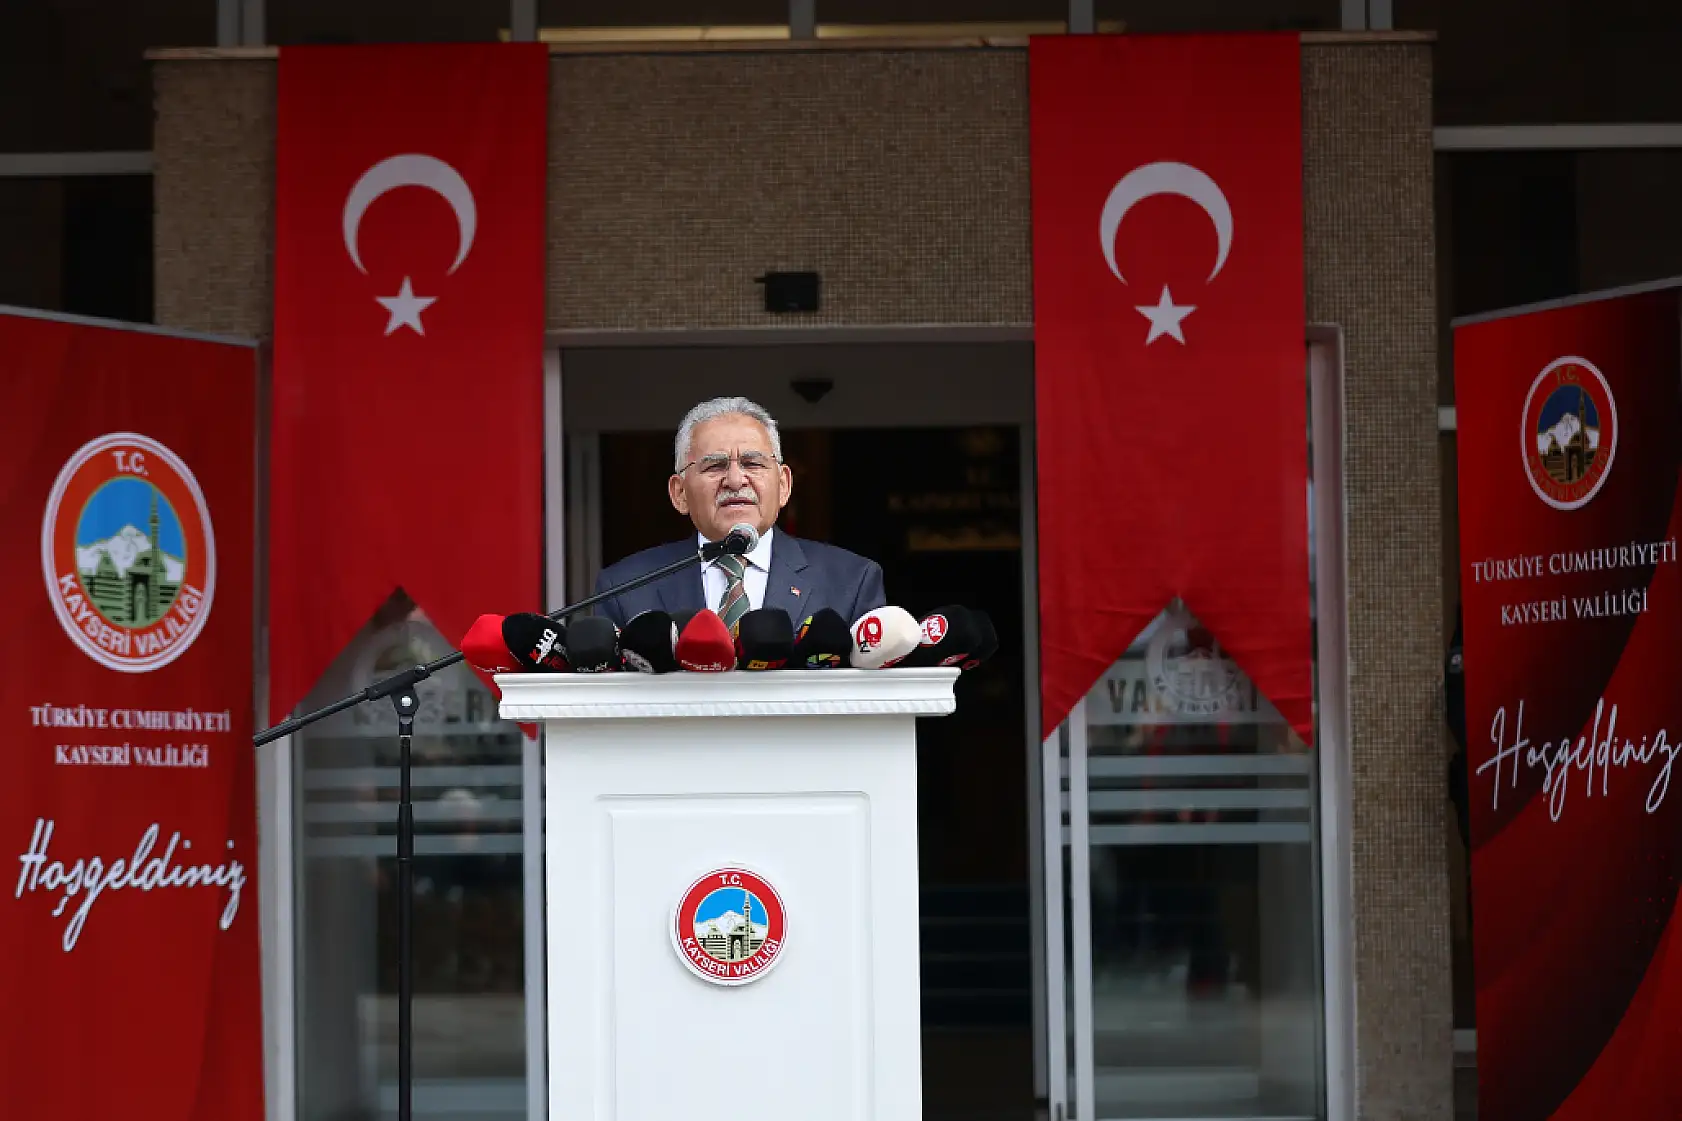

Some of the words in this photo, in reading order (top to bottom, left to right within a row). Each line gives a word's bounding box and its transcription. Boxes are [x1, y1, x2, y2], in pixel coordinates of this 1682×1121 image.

[111, 450, 149, 476] T.C.
[1471, 553, 1544, 583] TÜRKİYE
[1549, 536, 1677, 575] CUMHURİYETİ
[59, 572, 130, 656] KAYSERİ
[1500, 594, 1567, 626] KAYSERİ
[1572, 586, 1649, 618] VALİLİĞİ
[29, 702, 109, 728] TÜRKİYE
[110, 707, 231, 733] CUMHURİYETİ
[55, 742, 130, 766] KAYSERİ
[133, 743, 209, 768] VALİLİĞİ
[15, 817, 247, 952] Hoşgeldiniz
[718, 874, 743, 886] T.C.
[682, 937, 730, 976] KAYSERİ
